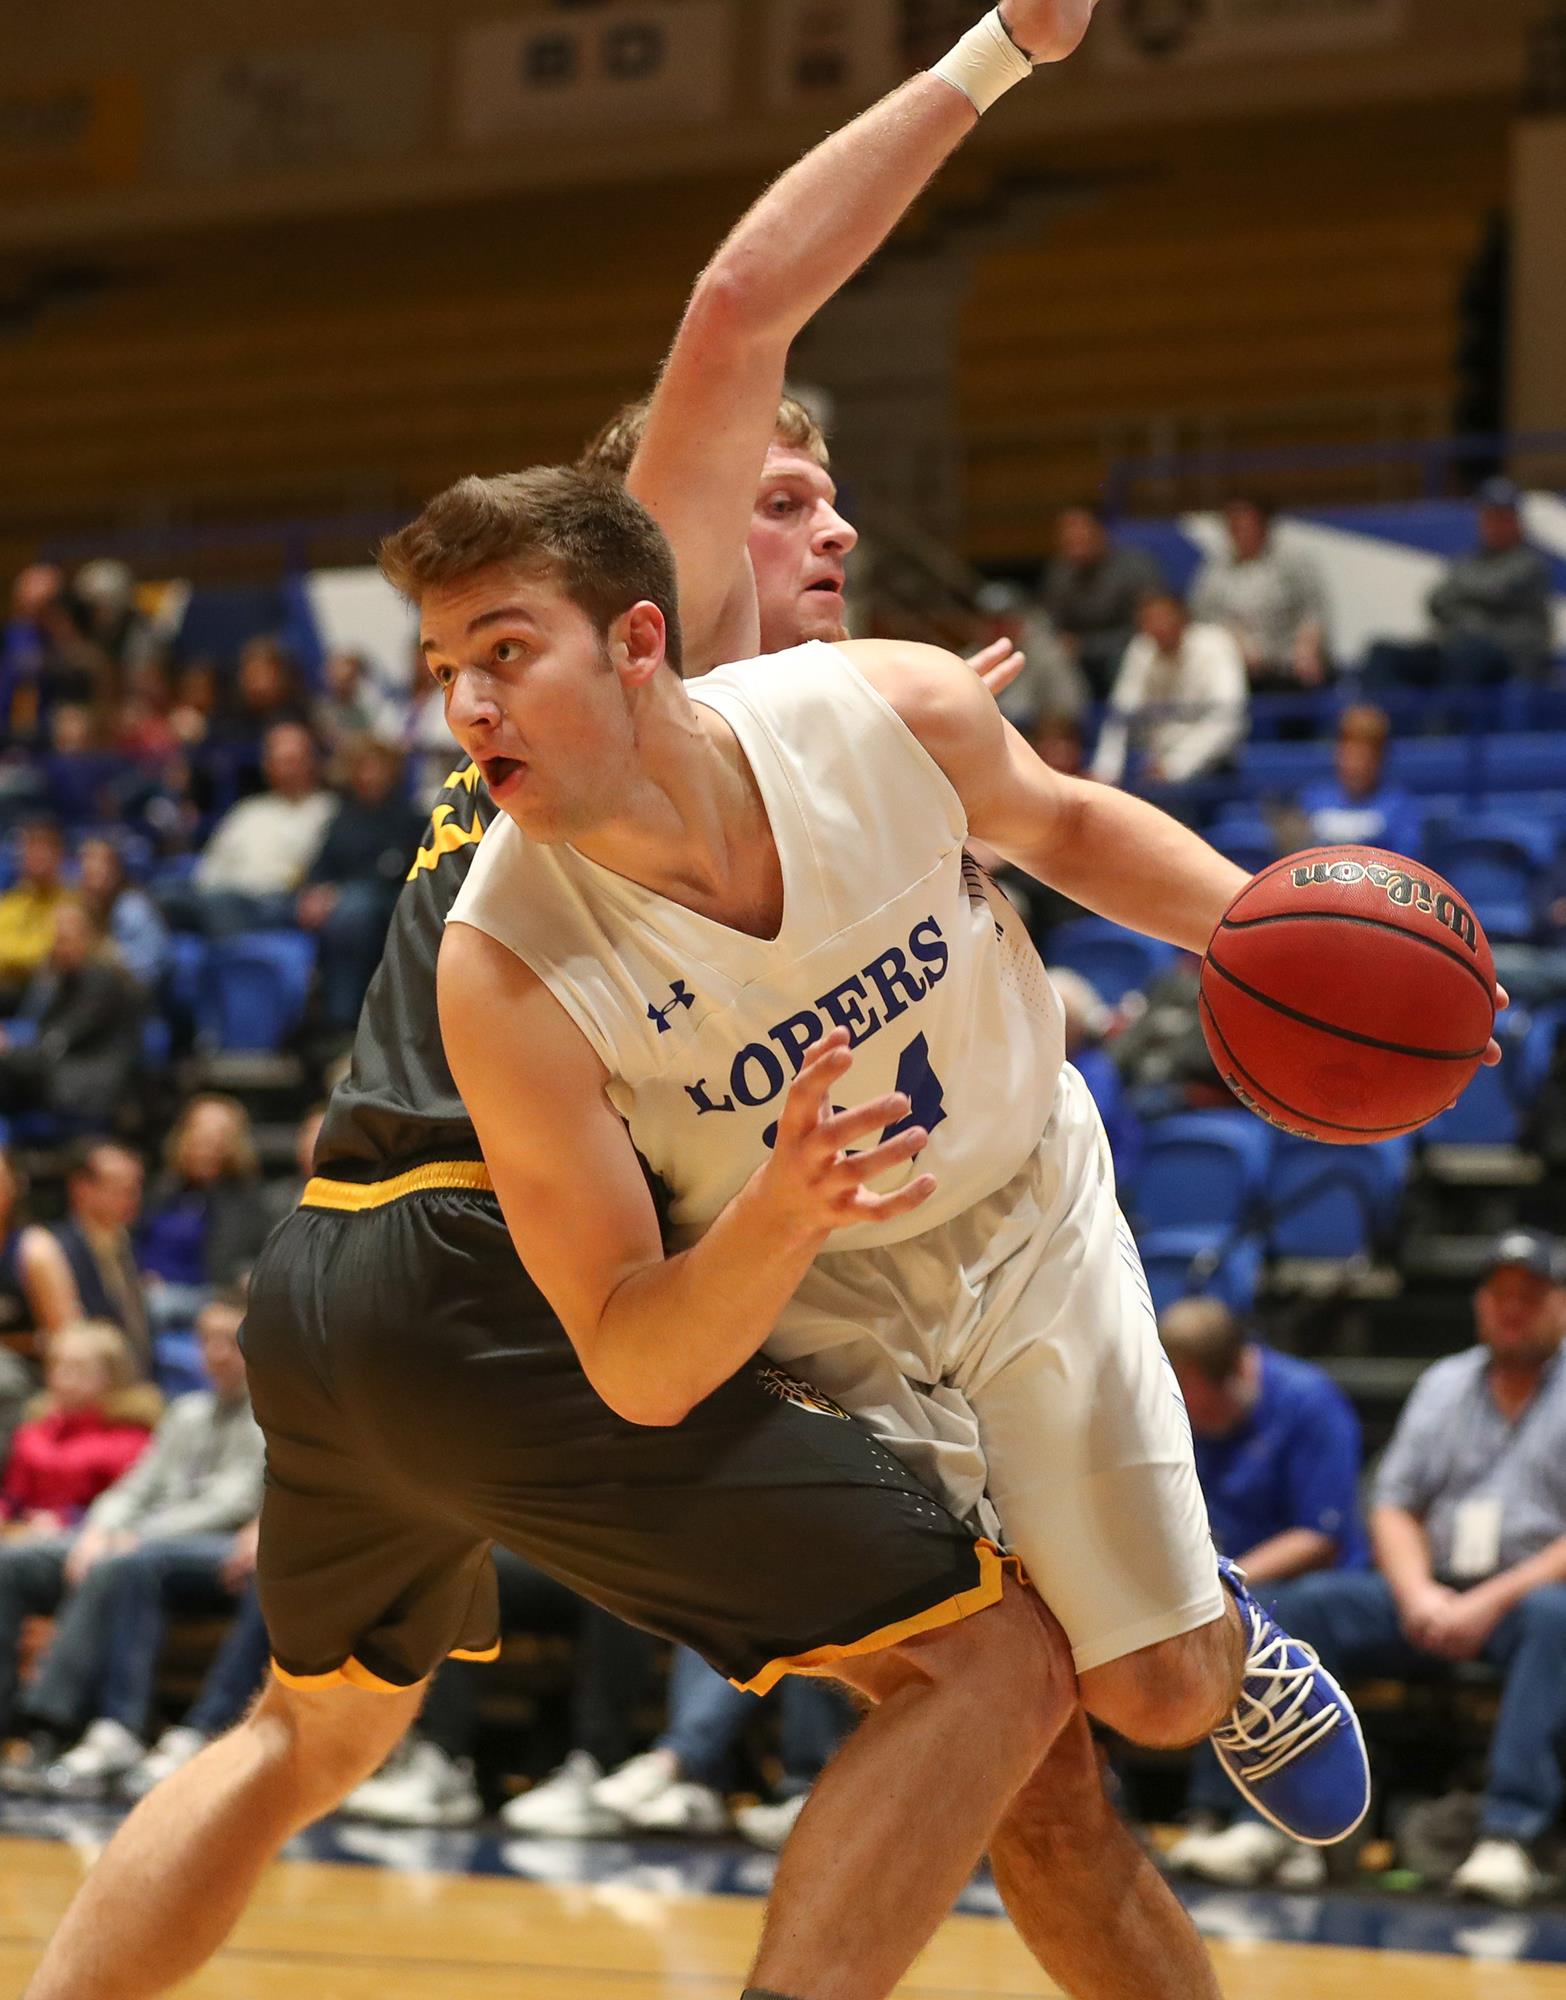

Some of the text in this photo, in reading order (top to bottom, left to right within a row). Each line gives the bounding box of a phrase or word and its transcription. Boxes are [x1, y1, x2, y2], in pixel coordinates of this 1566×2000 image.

[1290, 861, 1478, 954] Wilson
[684, 915, 949, 1115] LOPERS
[762, 1030, 948, 1163] 4
